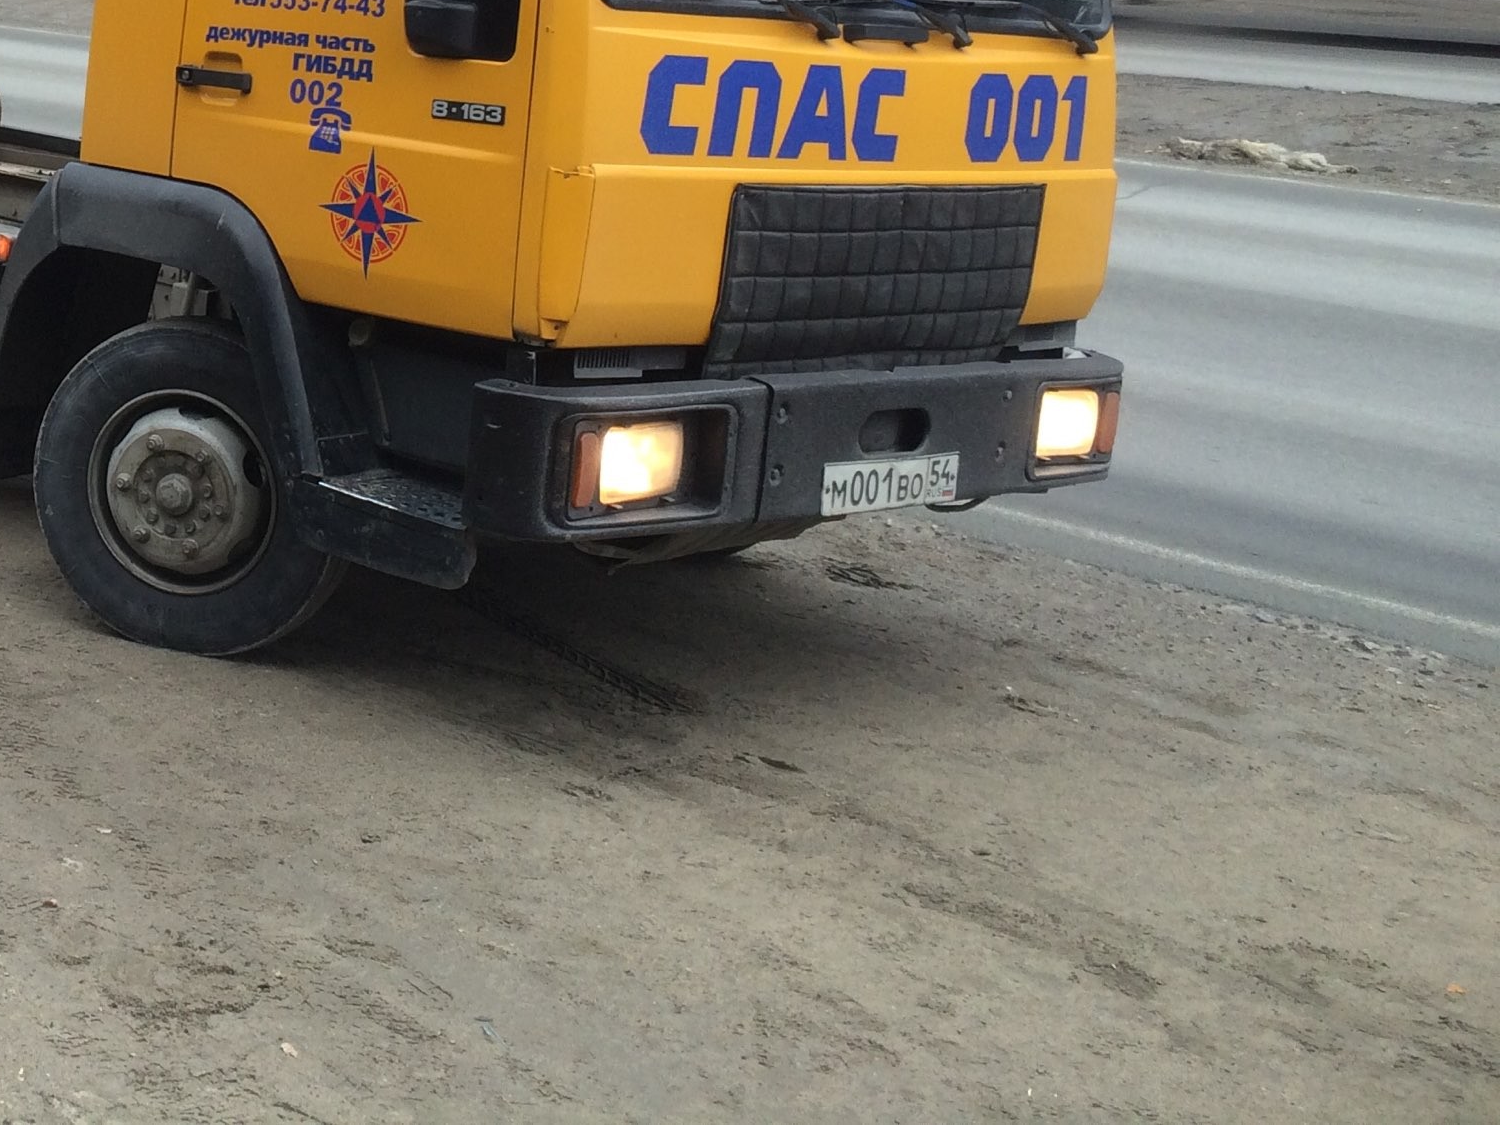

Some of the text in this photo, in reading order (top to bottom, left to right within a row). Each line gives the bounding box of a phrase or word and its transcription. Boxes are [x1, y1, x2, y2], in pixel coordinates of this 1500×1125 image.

[206, 26, 376, 53] дежурная часть
[292, 52, 373, 82] ГИБДД
[289, 78, 343, 107] 002
[640, 54, 1088, 163] СПАС 001
